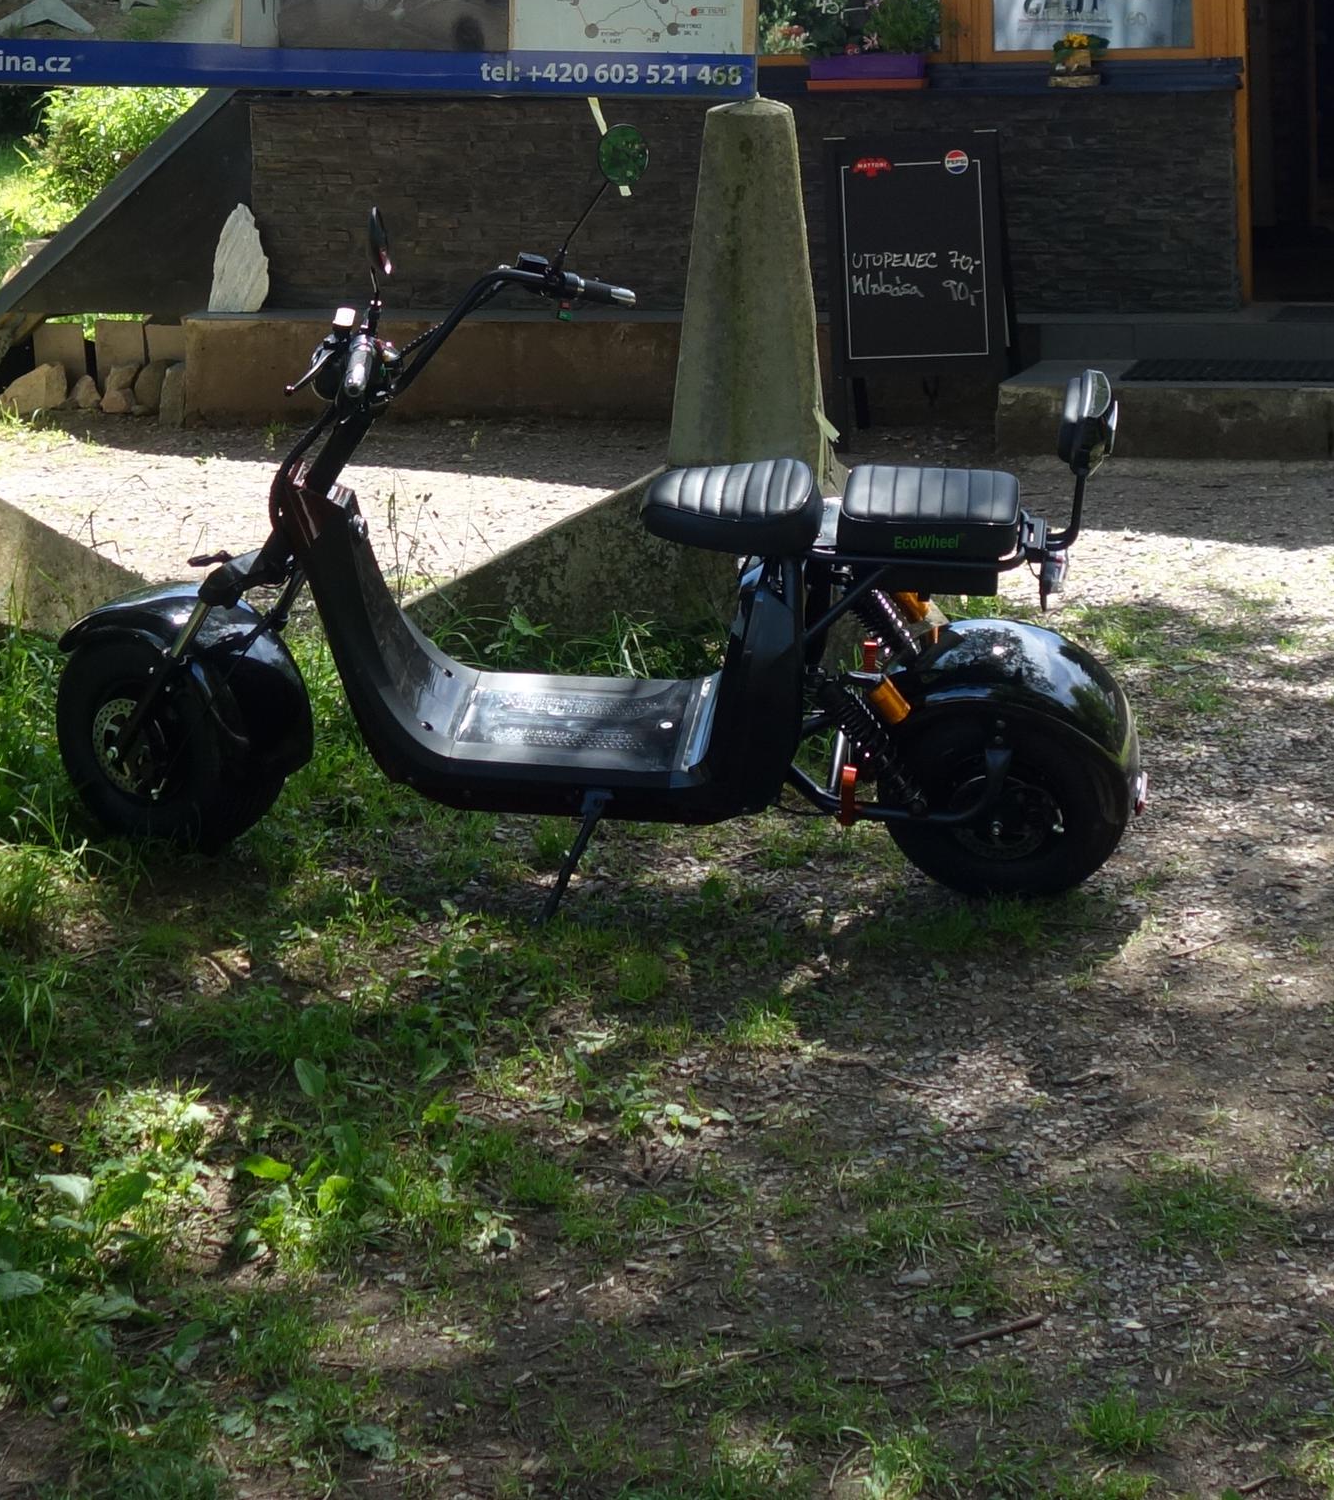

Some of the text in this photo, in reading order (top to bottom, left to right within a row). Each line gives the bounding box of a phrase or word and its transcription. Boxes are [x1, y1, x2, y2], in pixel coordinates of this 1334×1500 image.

[480, 61, 743, 86] tel: +420 603 521 468
[852, 251, 939, 269] UTOPENEC
[893, 534, 960, 549] EcoWheel
